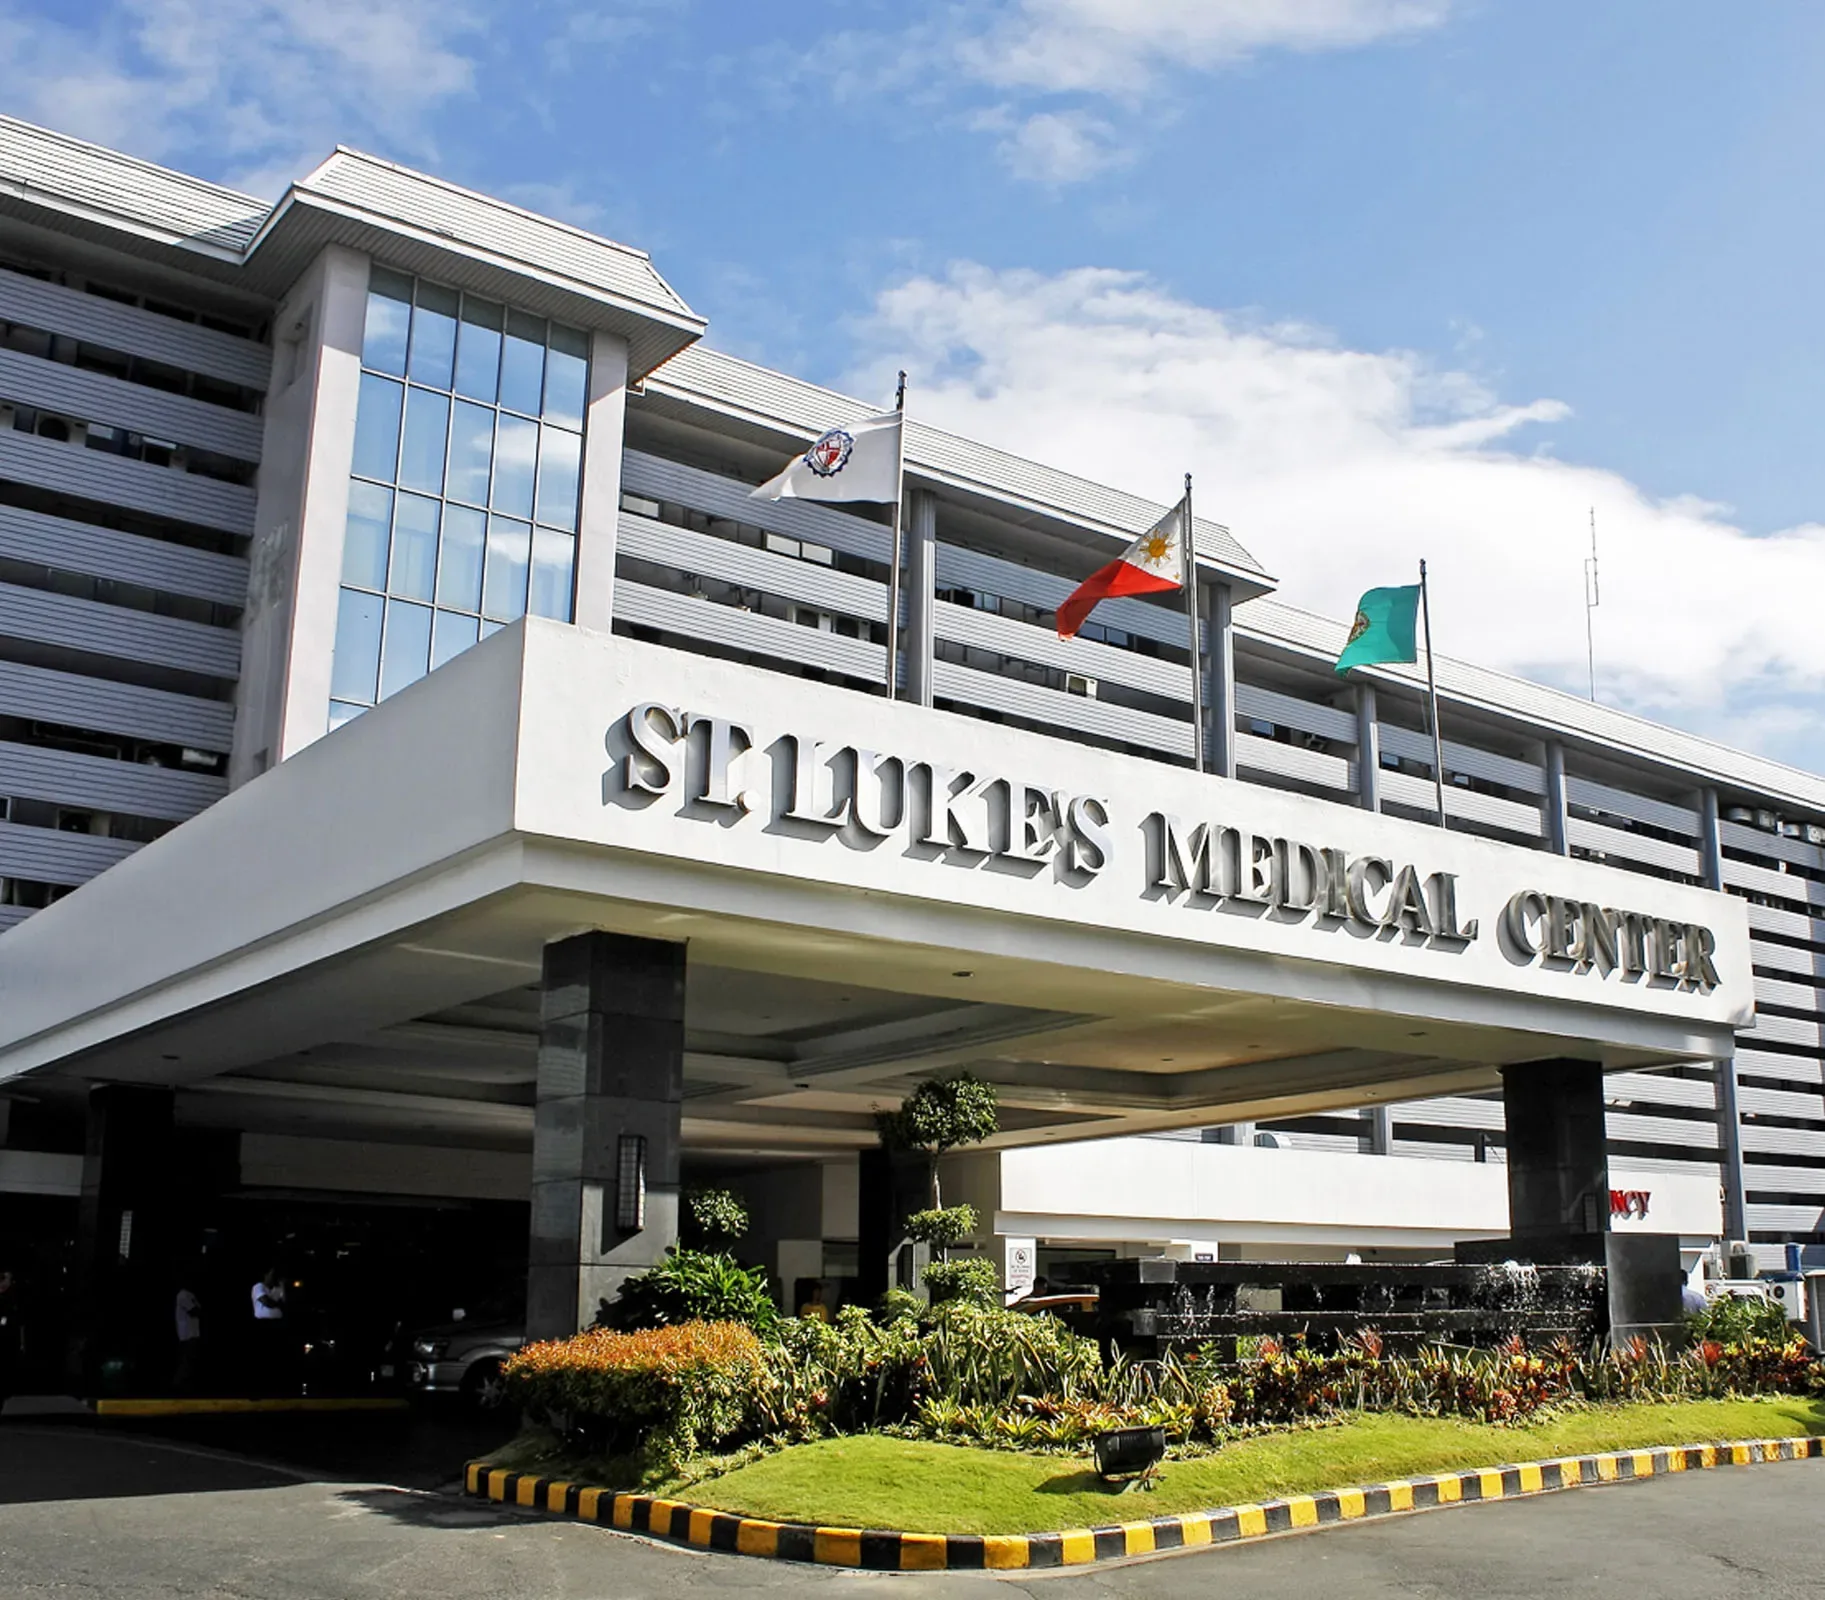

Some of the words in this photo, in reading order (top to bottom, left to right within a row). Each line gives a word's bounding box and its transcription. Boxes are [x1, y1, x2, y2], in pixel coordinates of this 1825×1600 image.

[780, 733, 1114, 874] LUKE'S
[1150, 810, 1479, 942] MEDICAL
[1503, 888, 1722, 988] CENTER
